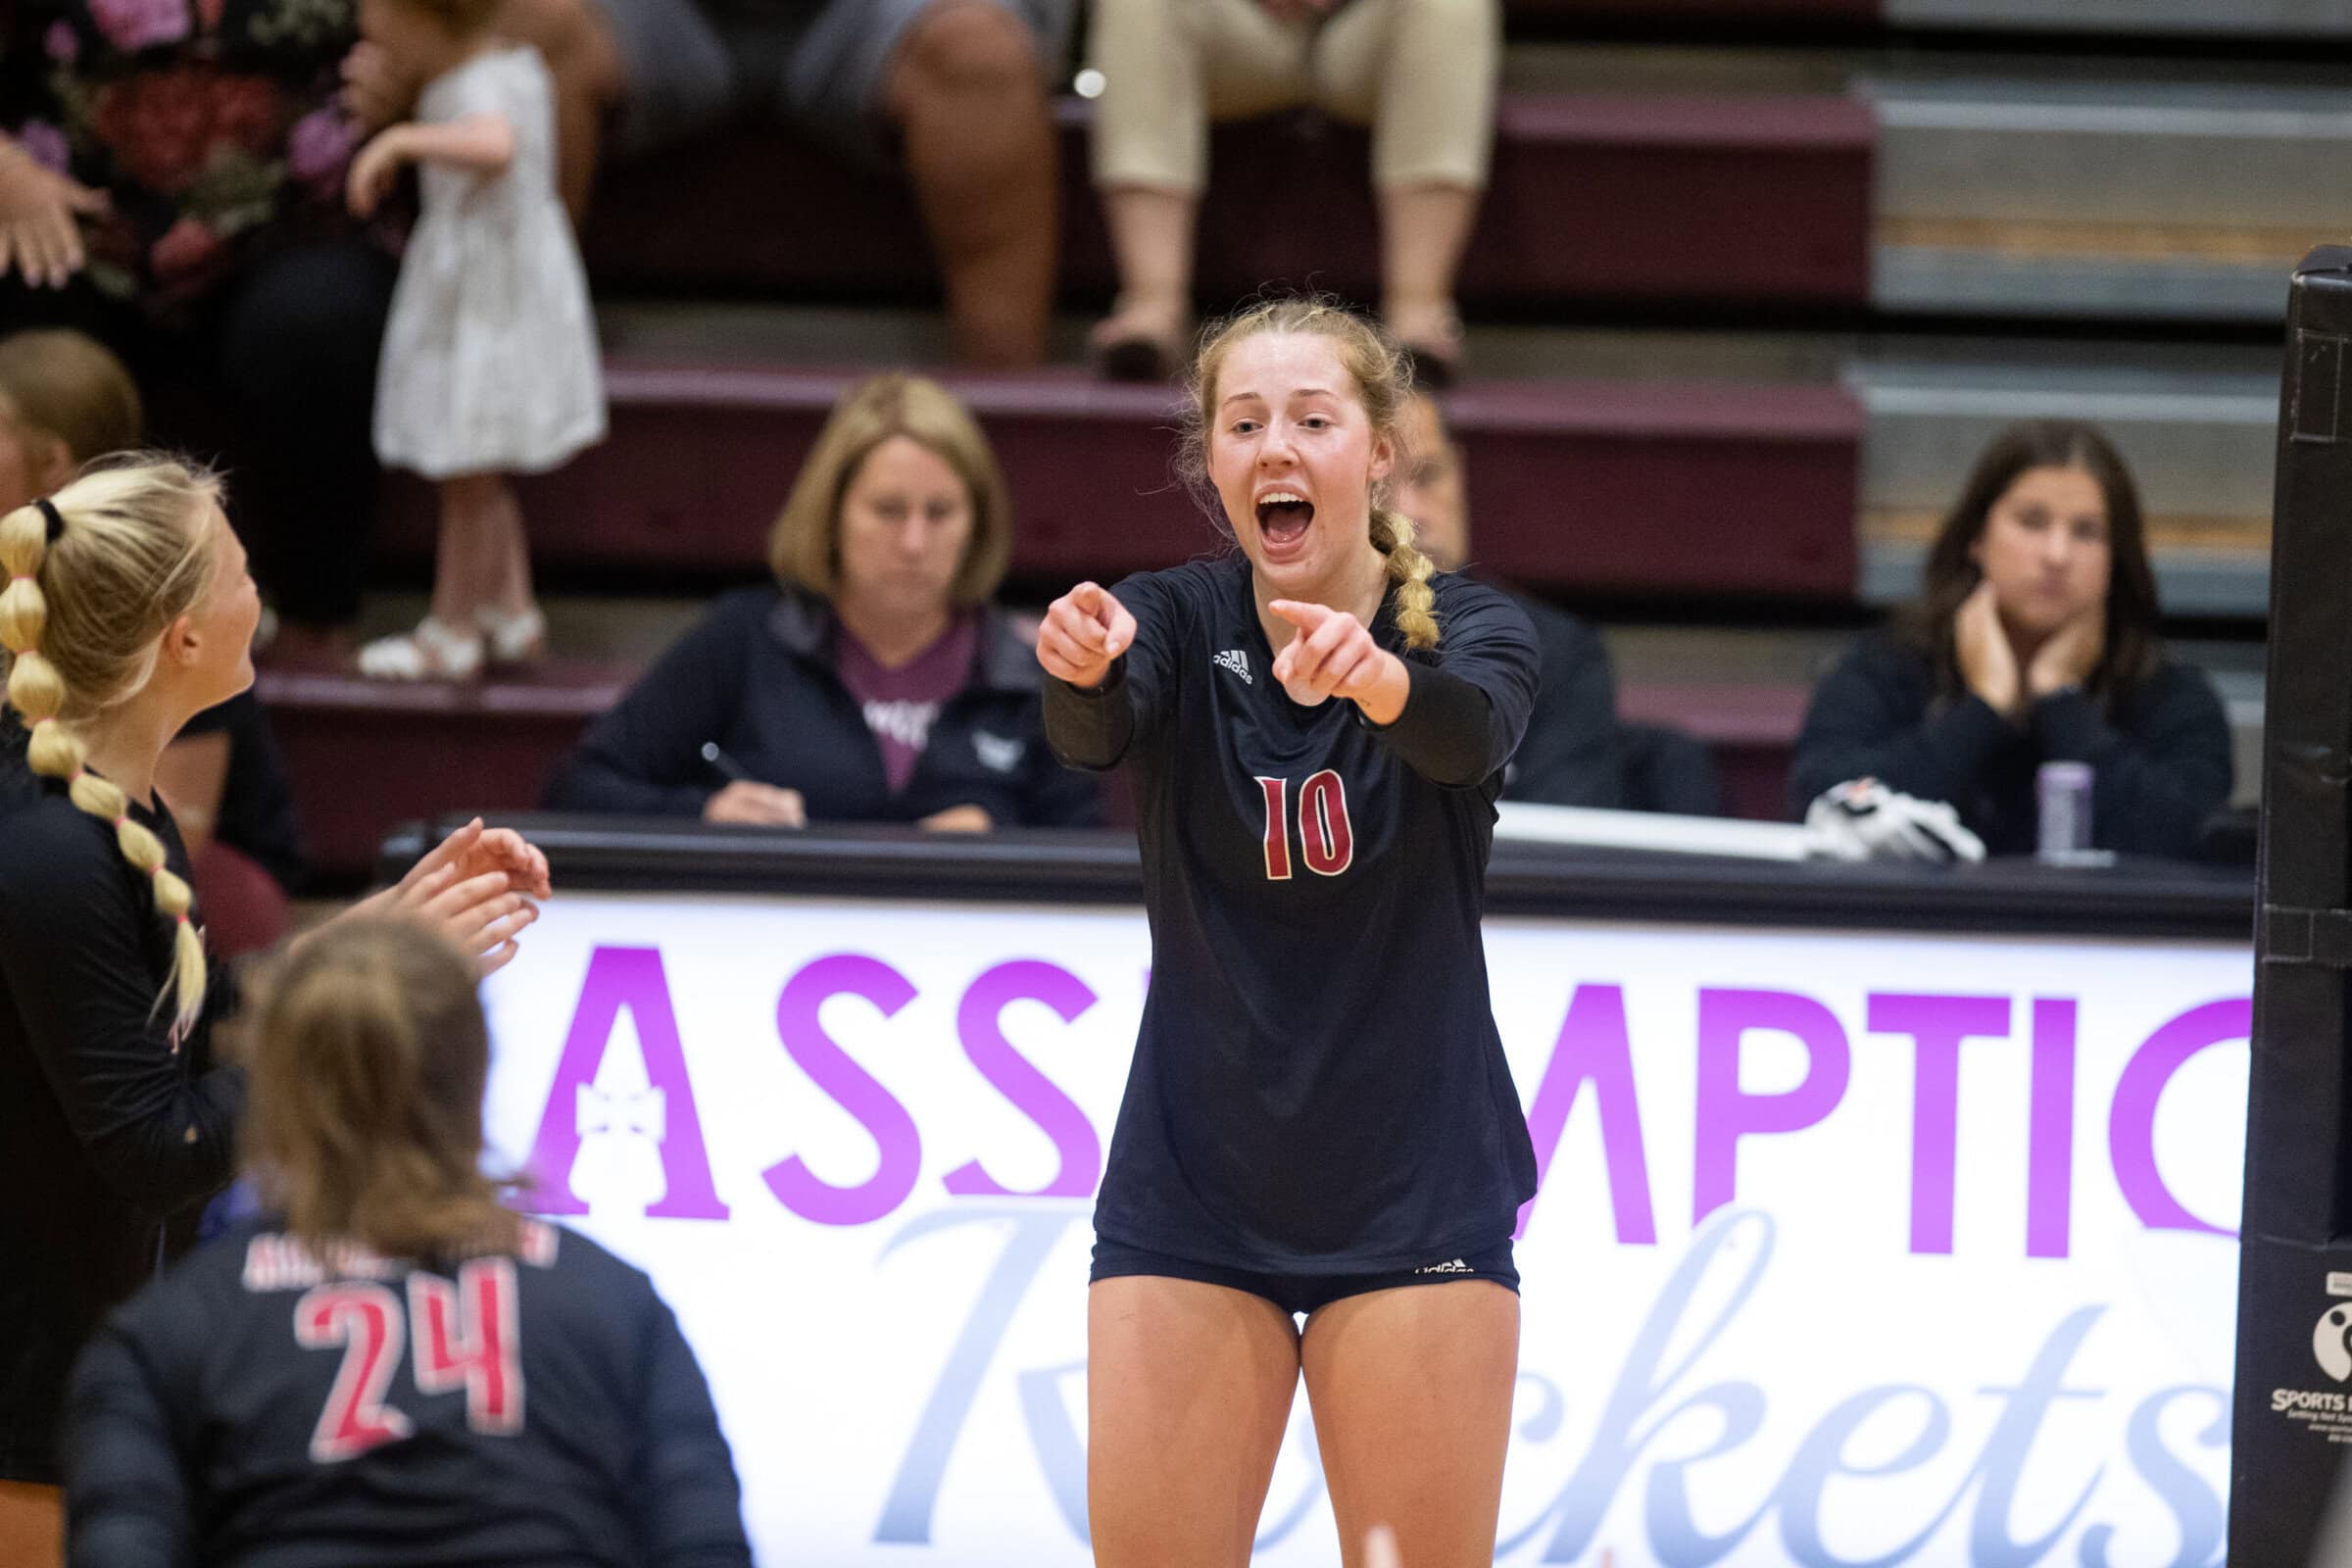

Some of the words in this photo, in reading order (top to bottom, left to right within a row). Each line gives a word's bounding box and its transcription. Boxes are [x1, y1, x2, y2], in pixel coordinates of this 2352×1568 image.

[1213, 654, 1253, 685] adidas
[1253, 768, 1353, 880] 10
[294, 1255, 526, 1463] 24
[2271, 1388, 2345, 1411] SPORTS
